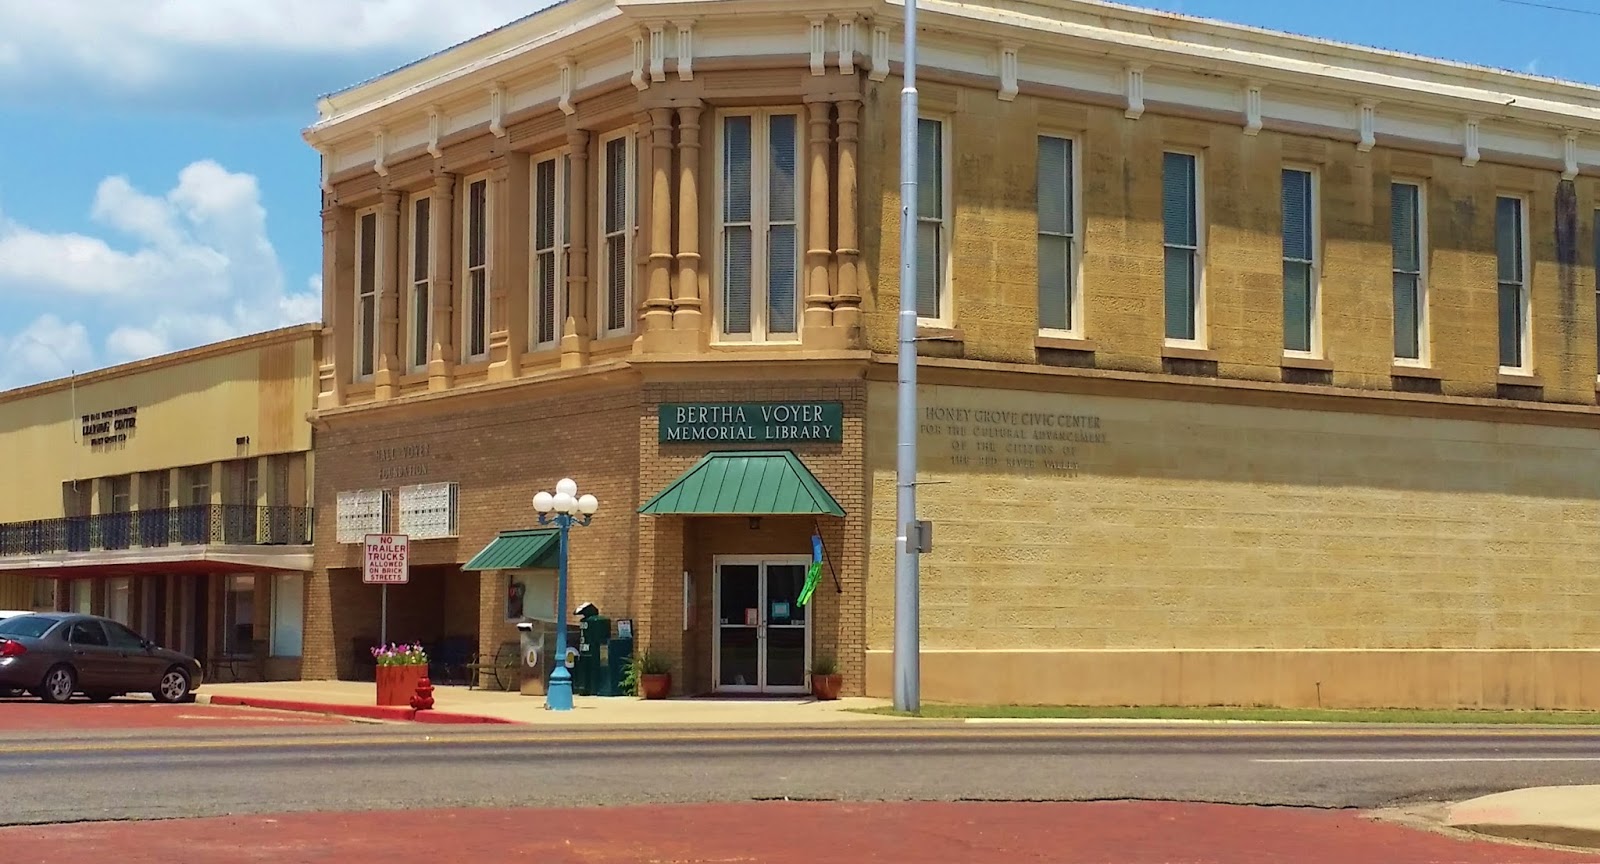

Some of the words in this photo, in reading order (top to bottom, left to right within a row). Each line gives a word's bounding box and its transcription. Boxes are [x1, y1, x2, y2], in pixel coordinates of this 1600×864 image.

[676, 406, 746, 424] BERTHA
[761, 405, 823, 423] VOYER
[926, 407, 971, 421] HONEY
[975, 410, 1018, 426] GROVE
[1021, 412, 1055, 427] CIVIC
[1057, 415, 1101, 429] CENTER
[667, 426, 757, 441] MEMORIAL
[765, 425, 833, 439] LIBRARY
[920, 425, 941, 434] FOR
[948, 426, 966, 436] THE
[973, 427, 1026, 439] CULTURAL
[1033, 430, 1106, 443] ADVANCEMENT
[952, 441, 967, 452] OF
[977, 442, 996, 452] THE
[1006, 443, 1054, 455] CITIZENS
[1063, 446, 1077, 456] OF
[1044, 460, 1079, 470] VALLEY
[380, 536, 393, 544] NO
[367, 544, 406, 552] TRAILER
[368, 553, 405, 561] TRUCKS
